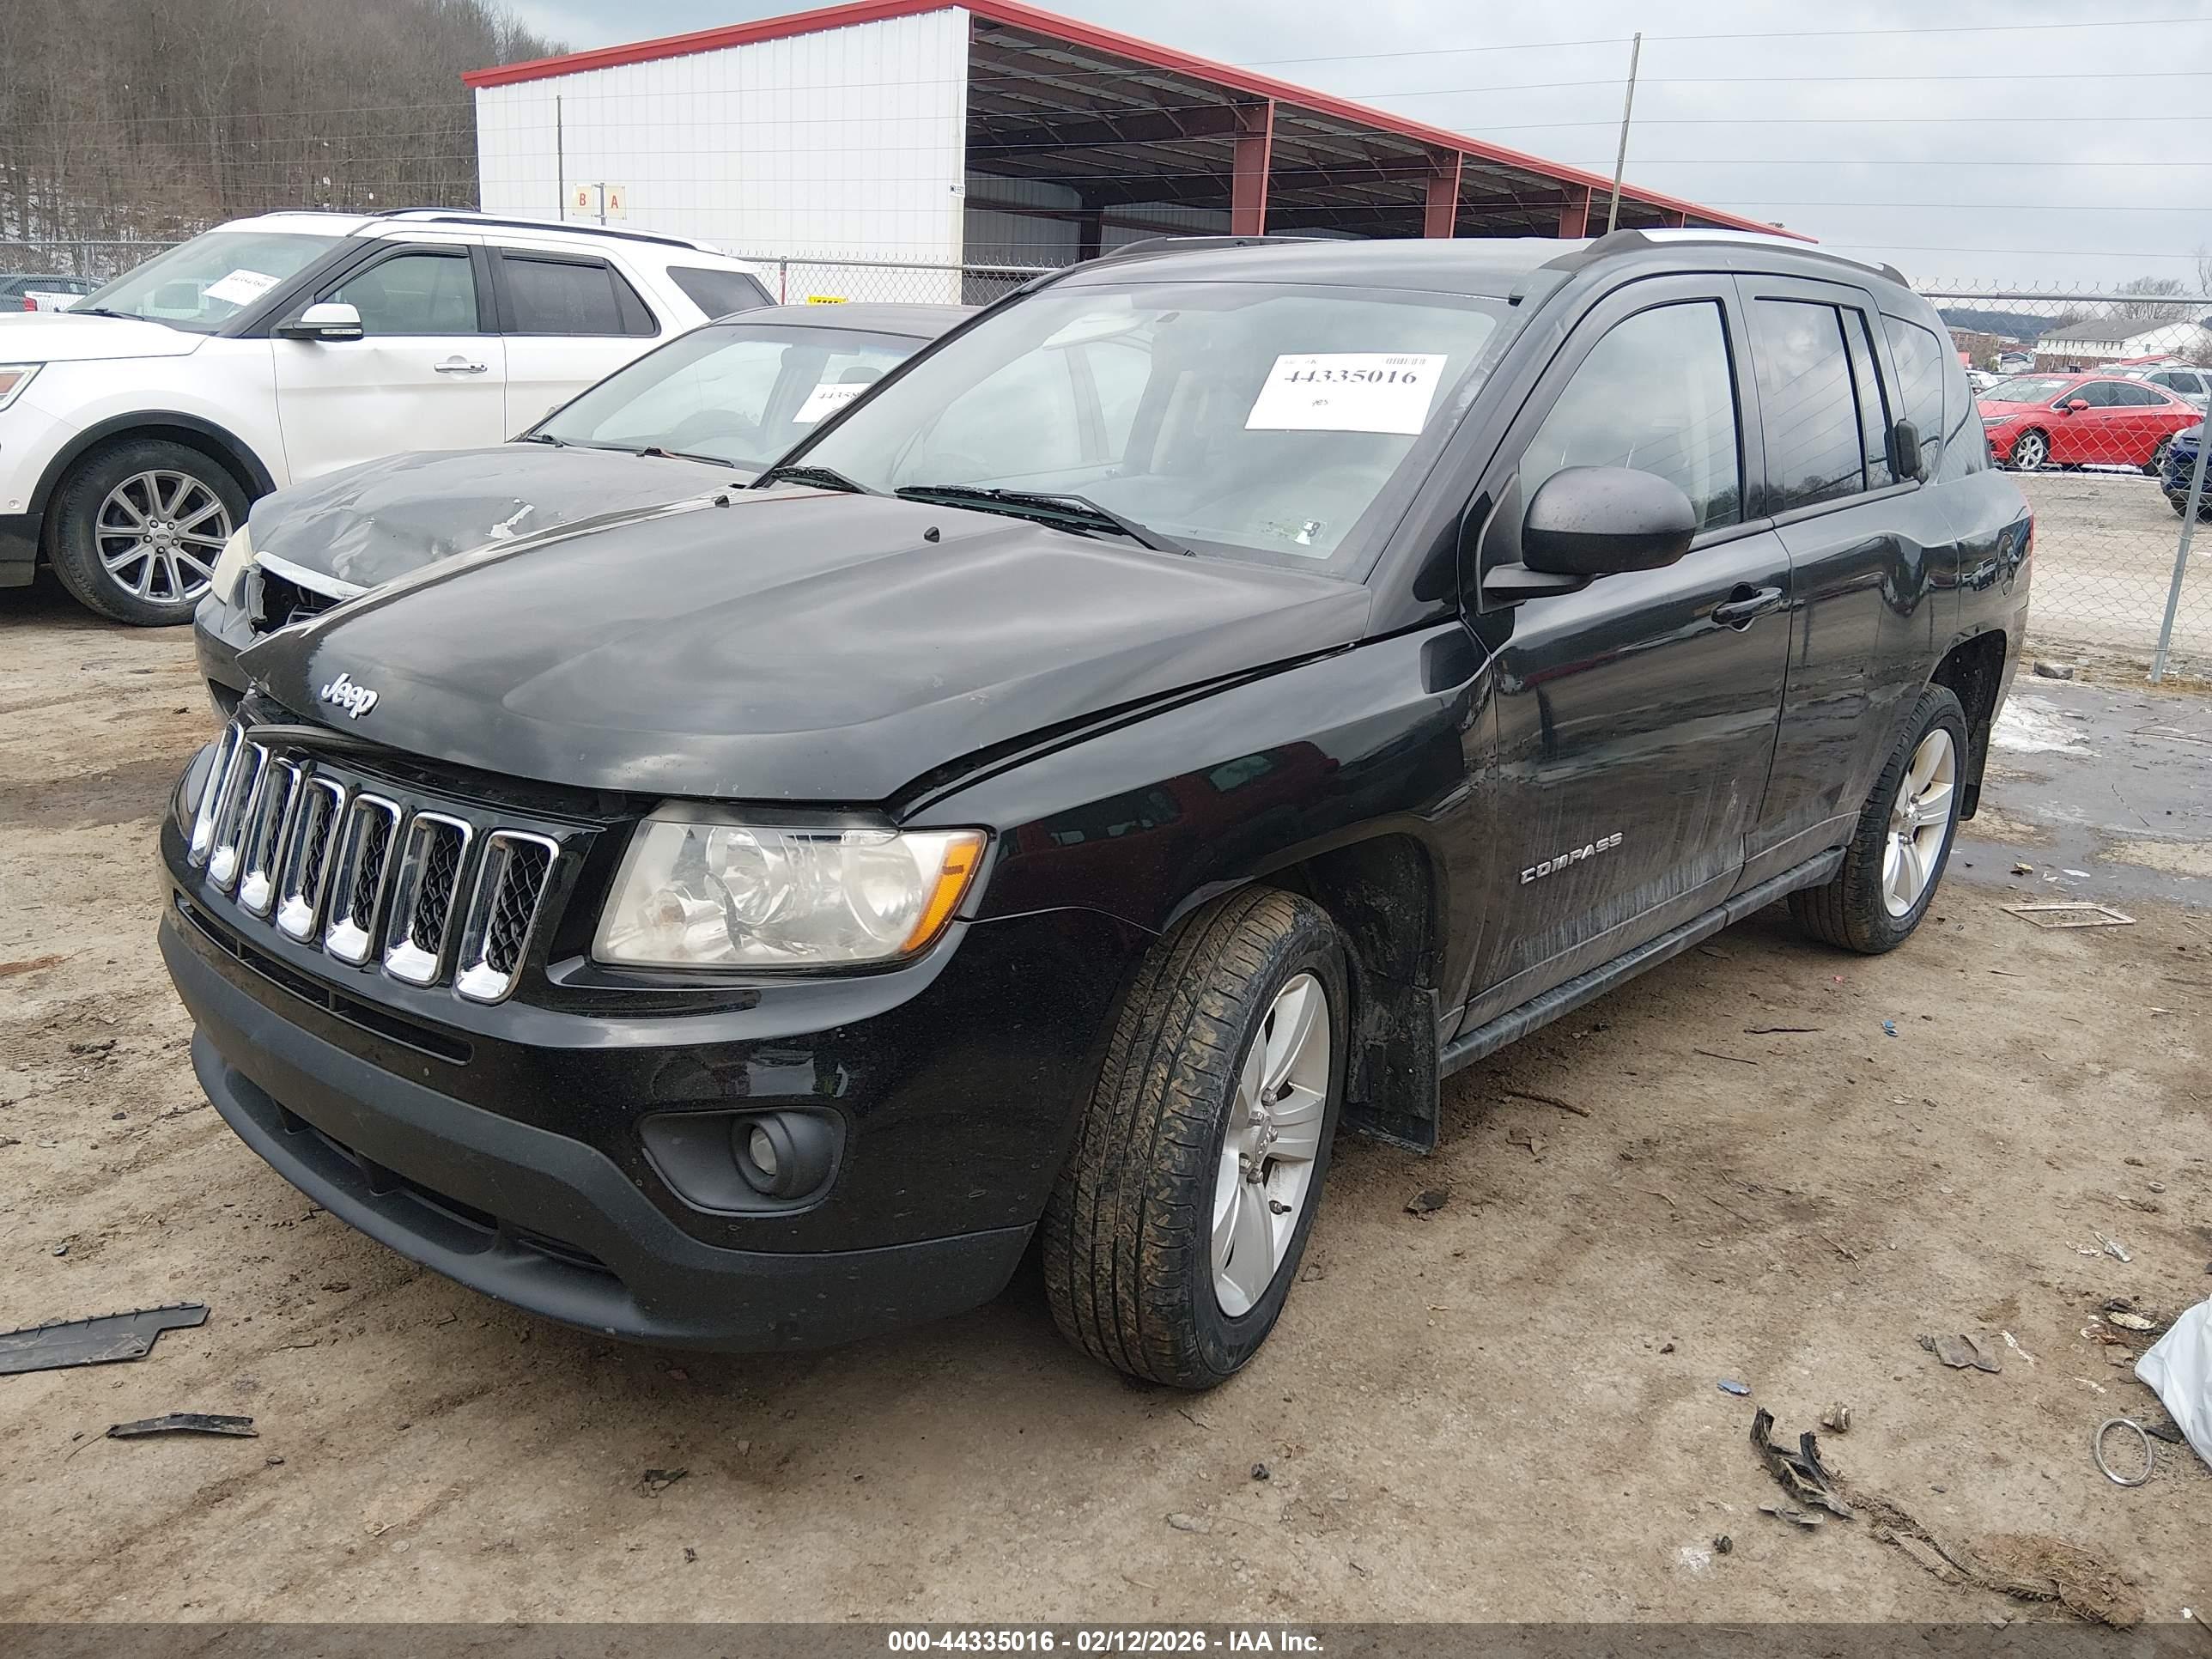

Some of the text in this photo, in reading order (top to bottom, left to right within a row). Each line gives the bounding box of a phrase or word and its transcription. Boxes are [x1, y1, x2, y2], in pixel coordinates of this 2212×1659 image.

[579, 192, 586, 206] B
[611, 195, 619, 209] A
[1284, 369, 1418, 385] 44335016
[321, 672, 379, 720] Jeep
[1520, 831, 1624, 885] COMPASS
